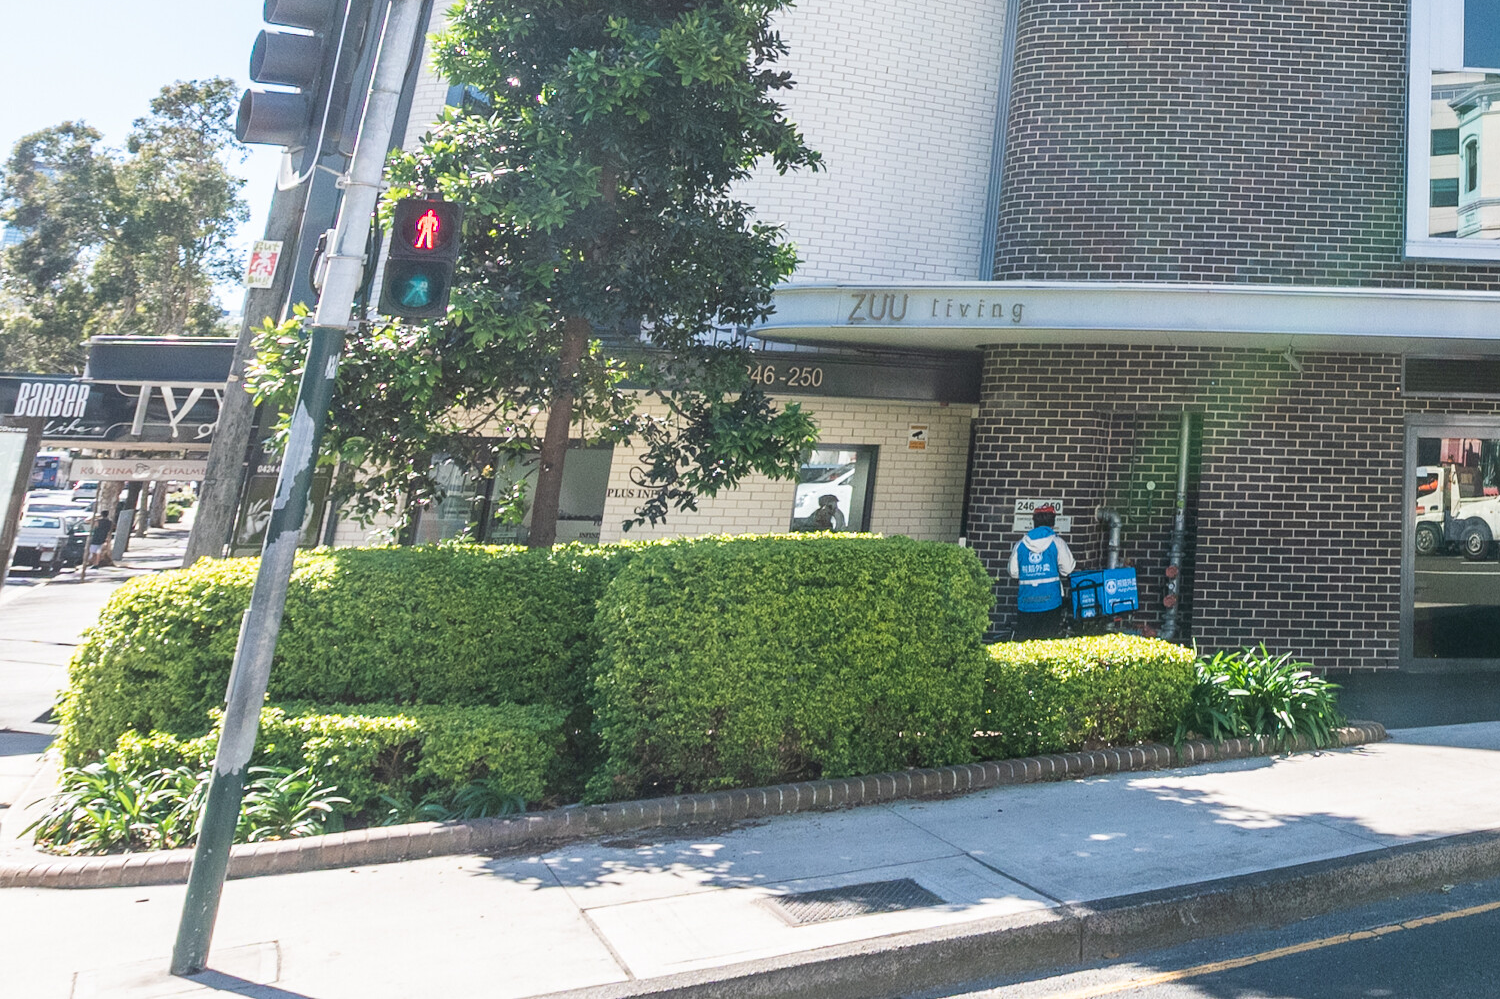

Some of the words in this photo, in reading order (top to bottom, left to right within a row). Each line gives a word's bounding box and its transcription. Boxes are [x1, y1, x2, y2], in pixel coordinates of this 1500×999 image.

[848, 292, 909, 323] ZUU
[930, 297, 1026, 323] living
[80, 465, 134, 475] KOUZINA
[607, 488, 635, 499] PLUS
[1017, 501, 1034, 511] 246
